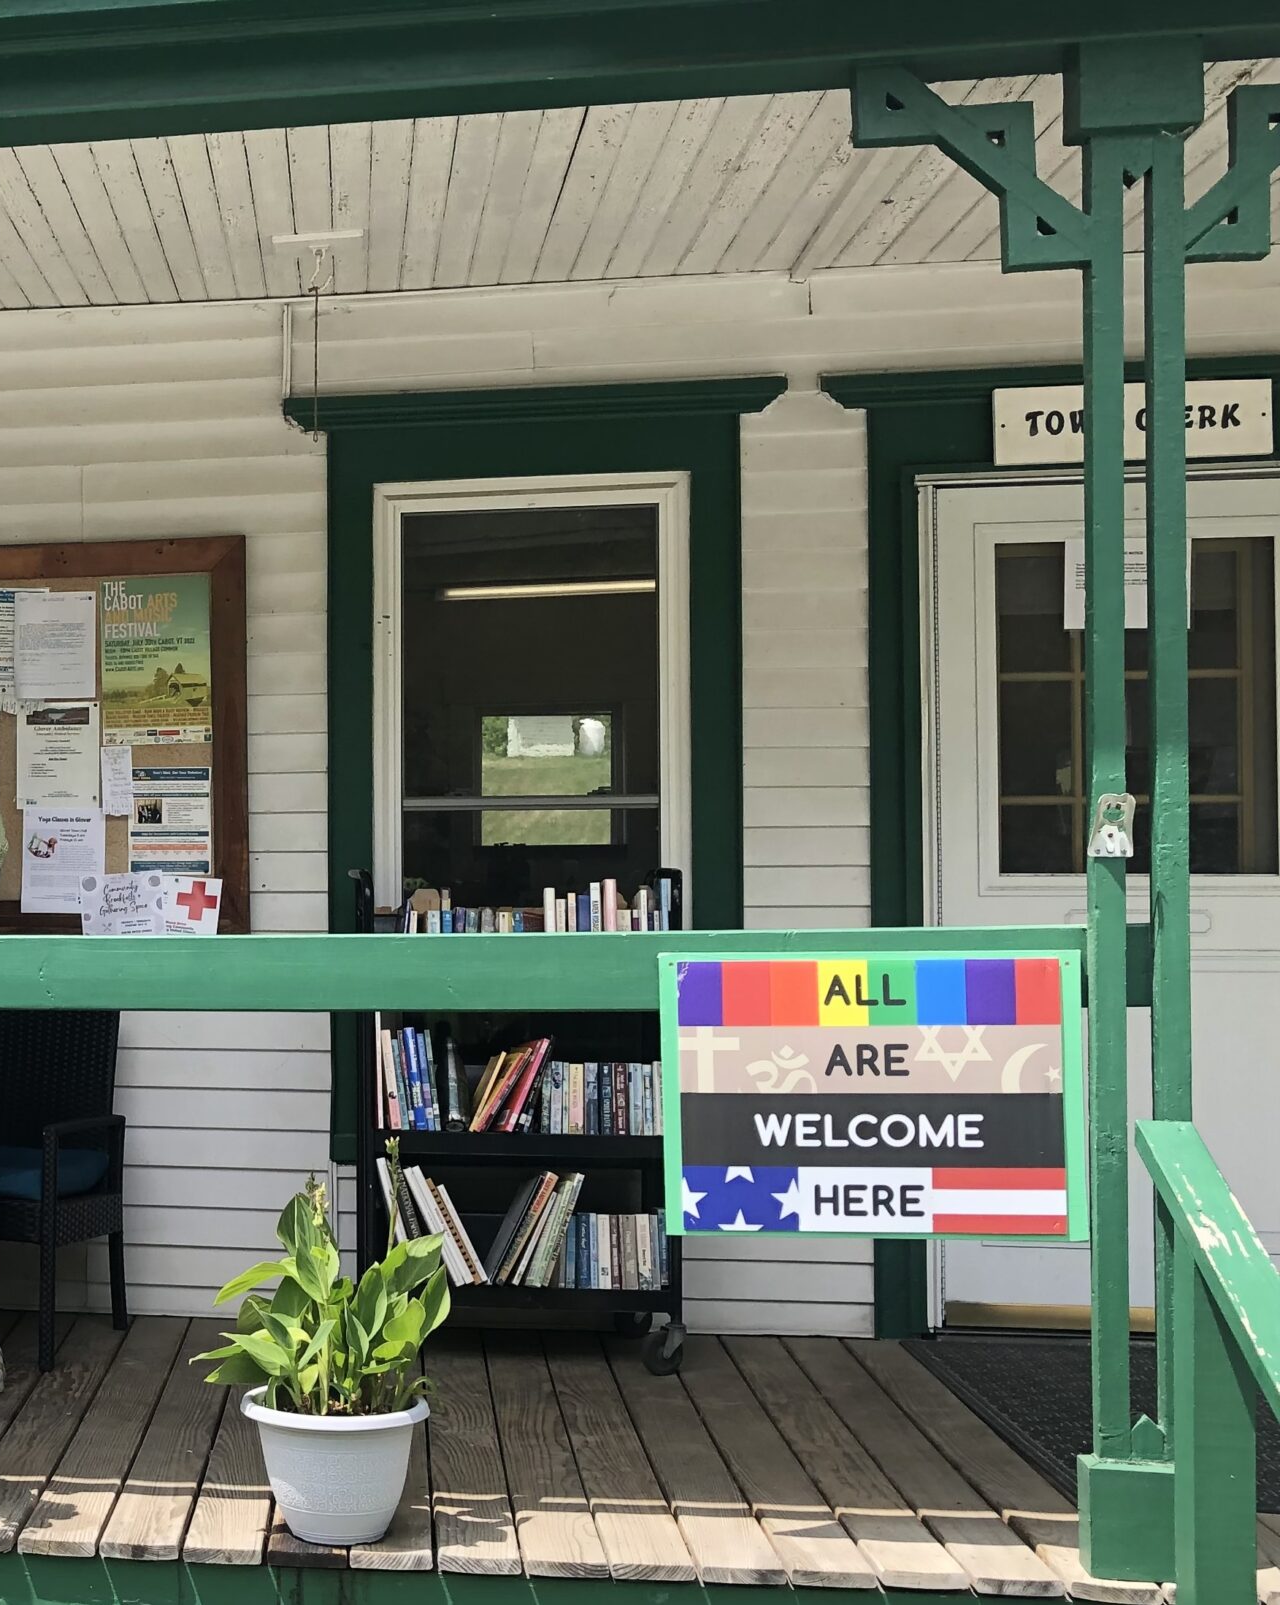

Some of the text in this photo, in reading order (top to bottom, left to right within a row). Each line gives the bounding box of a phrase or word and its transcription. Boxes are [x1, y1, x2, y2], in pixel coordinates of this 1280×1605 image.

[1025, 403, 1241, 437] TOW CERK
[103, 581, 126, 597] THE
[104, 592, 178, 611] CABOT ARTS
[105, 607, 173, 624] AND MUSIC
[105, 622, 160, 638] FESTIVAL
[38, 816, 51, 824] Yoga
[103, 880, 138, 895] Community
[100, 902, 148, 917] Gathering Space
[823, 974, 907, 1006] ALL
[824, 1043, 910, 1077] ARE
[753, 1113, 984, 1148] WELCOME
[814, 1184, 925, 1218] HERE
